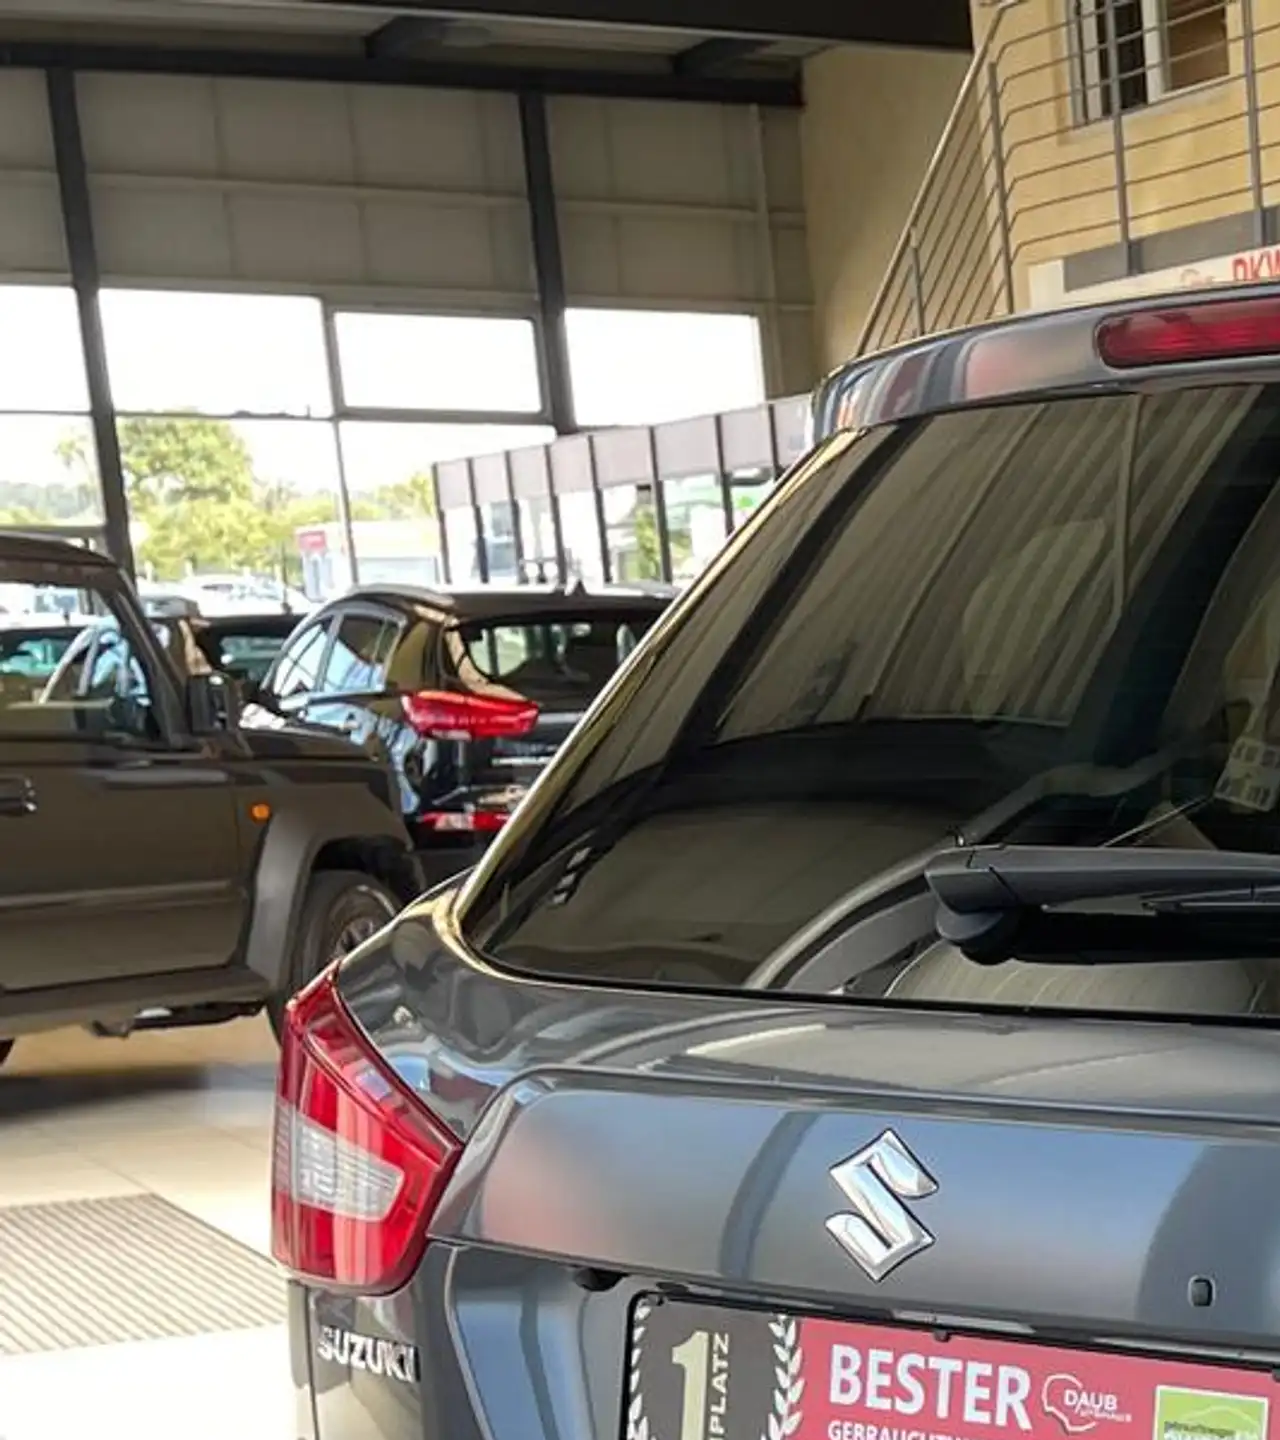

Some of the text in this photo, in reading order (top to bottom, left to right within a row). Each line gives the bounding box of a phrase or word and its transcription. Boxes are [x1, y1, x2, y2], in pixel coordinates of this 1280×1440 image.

[319, 1325, 418, 1383] SUZUKI
[709, 1332, 730, 1434] PLATZ
[829, 1344, 1032, 1431] BESTER
[1064, 1389, 1117, 1411] DAUB
